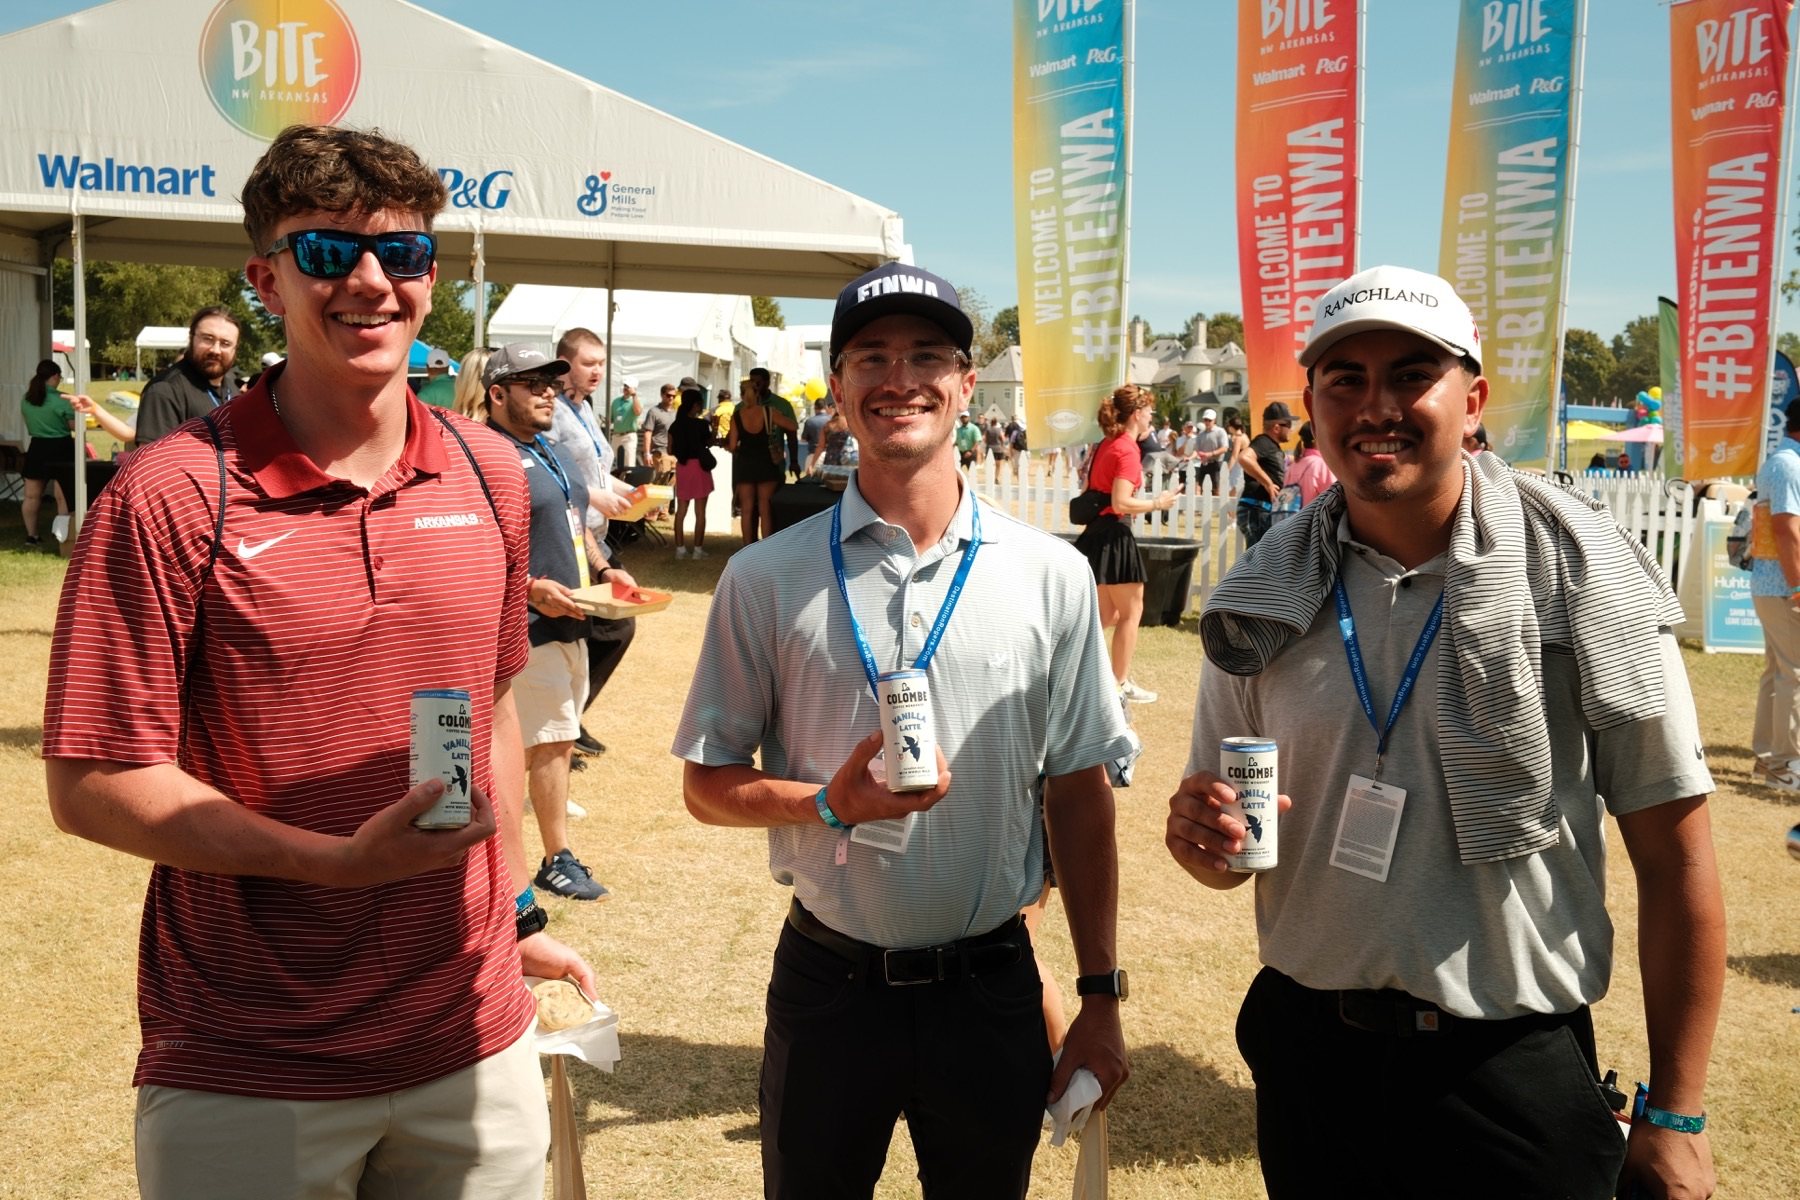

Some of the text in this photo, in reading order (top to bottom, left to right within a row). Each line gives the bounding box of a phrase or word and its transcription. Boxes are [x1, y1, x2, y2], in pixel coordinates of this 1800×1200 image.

[1053, 13, 1103, 33] ARKANSAS
[1482, 0, 1553, 52] BITE
[1280, 31, 1335, 51] ARKANSAS
[1696, 7, 1773, 75] BITE
[230, 19, 329, 88] BITE
[1029, 46, 1117, 78] Walmart P&G
[1498, 43, 1551, 63] ARKANSAS
[1252, 55, 1349, 86] Walmart P&G
[1710, 66, 1768, 85] ARKANSAS
[232, 89, 328, 104] NW ARKANSAS
[1468, 76, 1564, 106] Walmart P&G
[1744, 90, 1778, 109] P&G
[38, 154, 216, 197] Walmart
[437, 169, 514, 211] P&G
[612, 183, 656, 195] General
[612, 195, 637, 205] Mills
[1460, 192, 1489, 225] TO
[1060, 107, 1120, 363] #BITENWA
[1030, 166, 1064, 326] WELCOME TO
[1252, 174, 1291, 331] WELCOME TO
[1495, 137, 1558, 384] #BITENWA
[1695, 152, 1769, 400] #BITENWA
[857, 274, 939, 303] FTNWA
[1323, 287, 1439, 319] RANCHLAND
[414, 513, 479, 529] ARKANSAS
[922, 585, 960, 663] DestinationRogers.com
[857, 626, 880, 696] ationRogers.com
[902, 682, 911, 692] La
[887, 691, 927, 705] COLOMBE
[459, 703, 467, 715] La
[892, 711, 926, 725] VANILLA
[438, 714, 471, 729] COLOM
[900, 723, 921, 731] LATTE
[442, 738, 471, 752] VANILL
[1248, 757, 1258, 767] La
[1228, 766, 1274, 779] COLOMBE
[1241, 801, 1265, 809] LATTE
